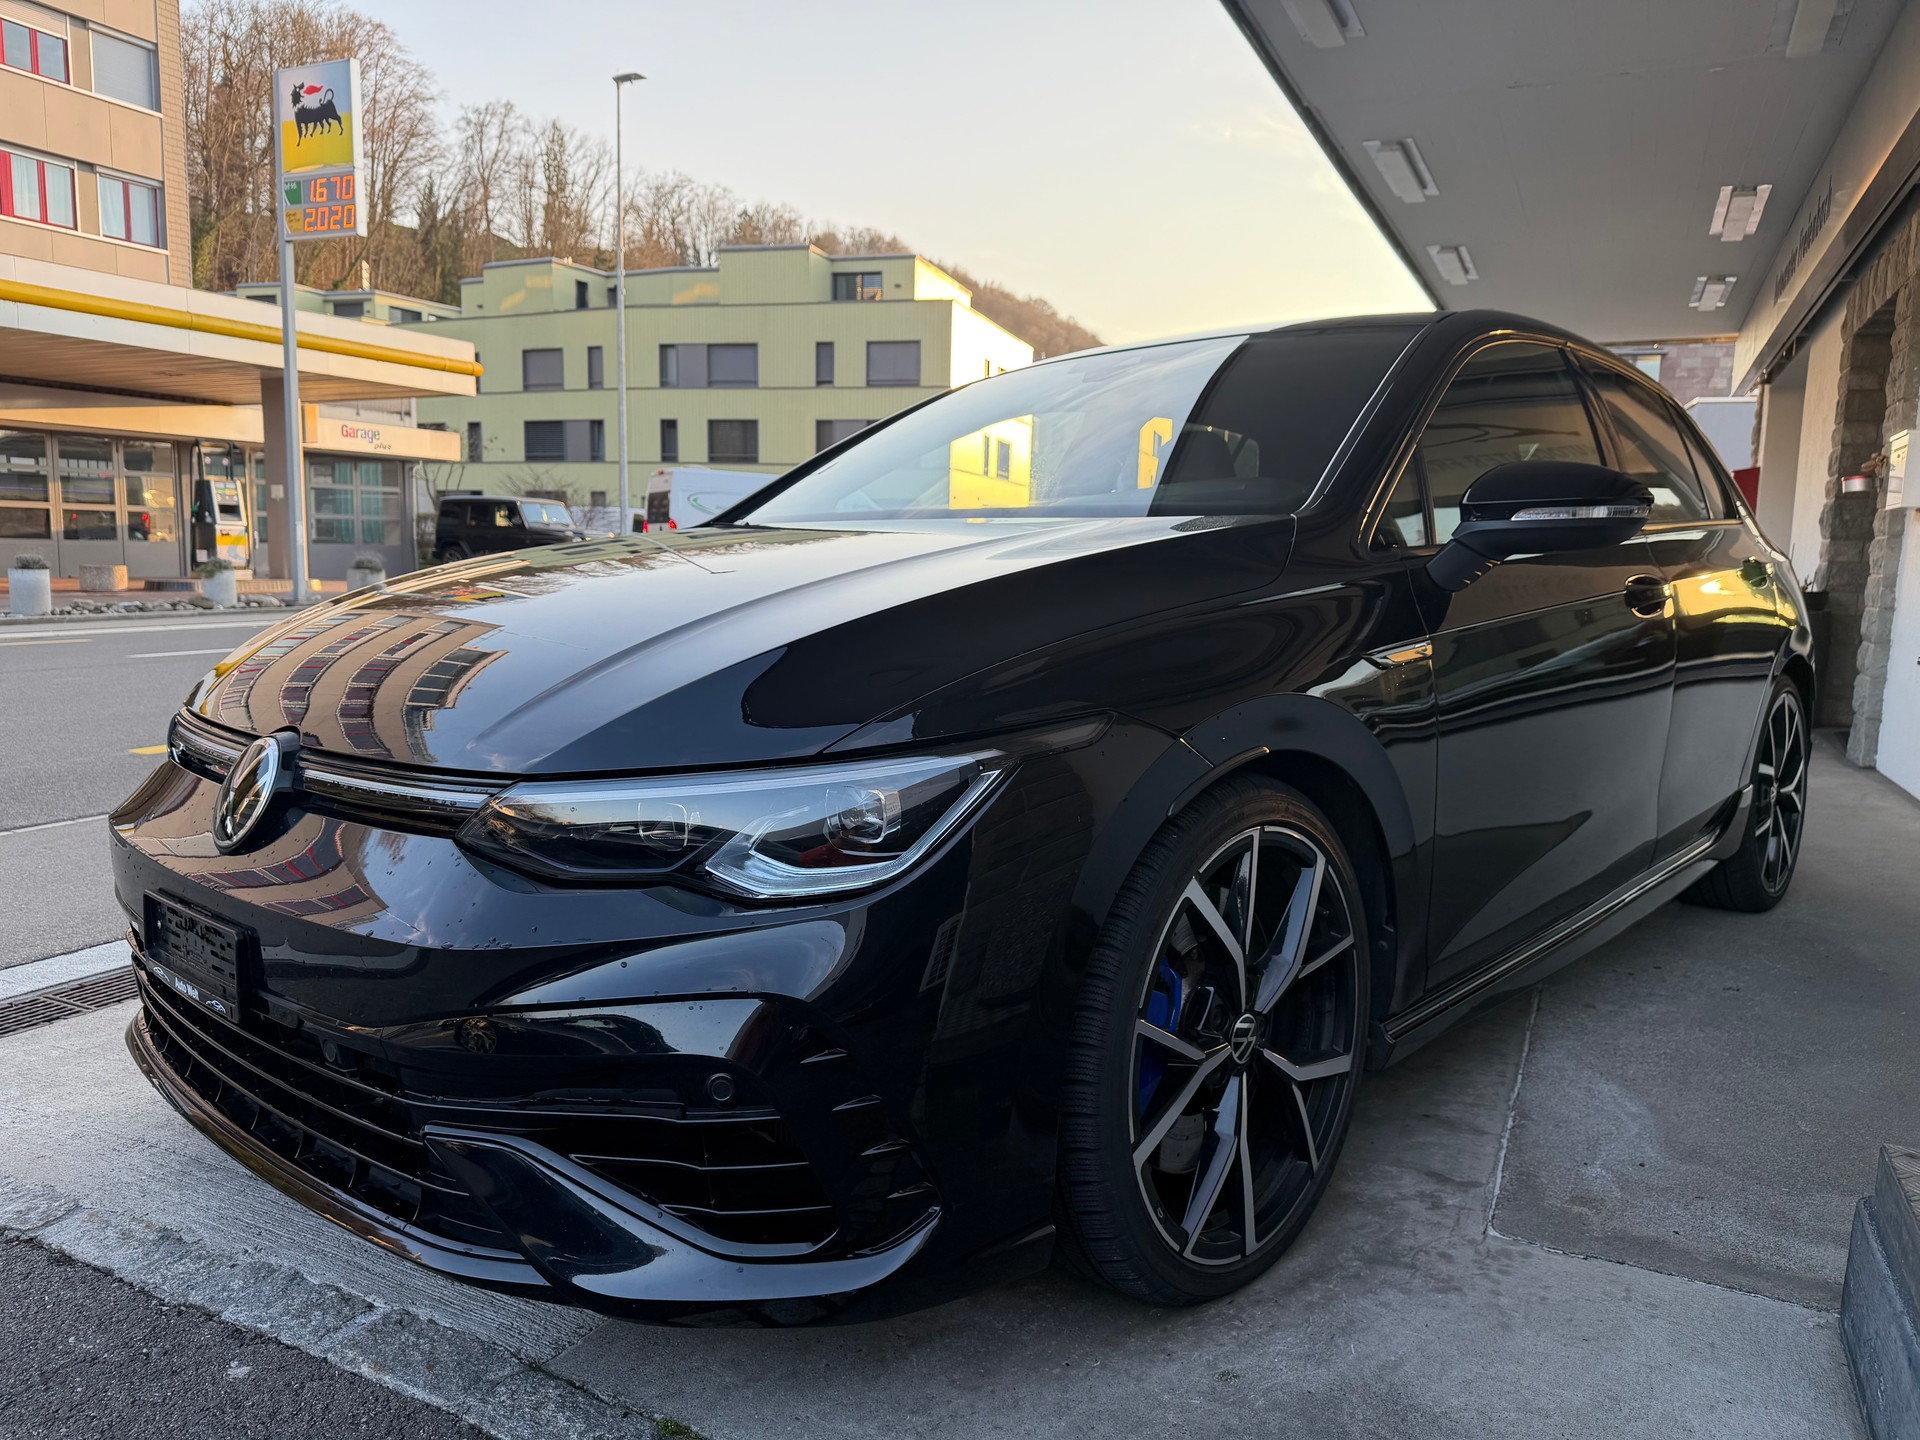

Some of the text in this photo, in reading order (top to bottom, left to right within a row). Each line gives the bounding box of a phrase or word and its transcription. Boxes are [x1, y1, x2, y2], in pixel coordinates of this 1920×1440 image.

[341, 424, 381, 443] Garage
[175, 976, 200, 1001] Auto Welt
